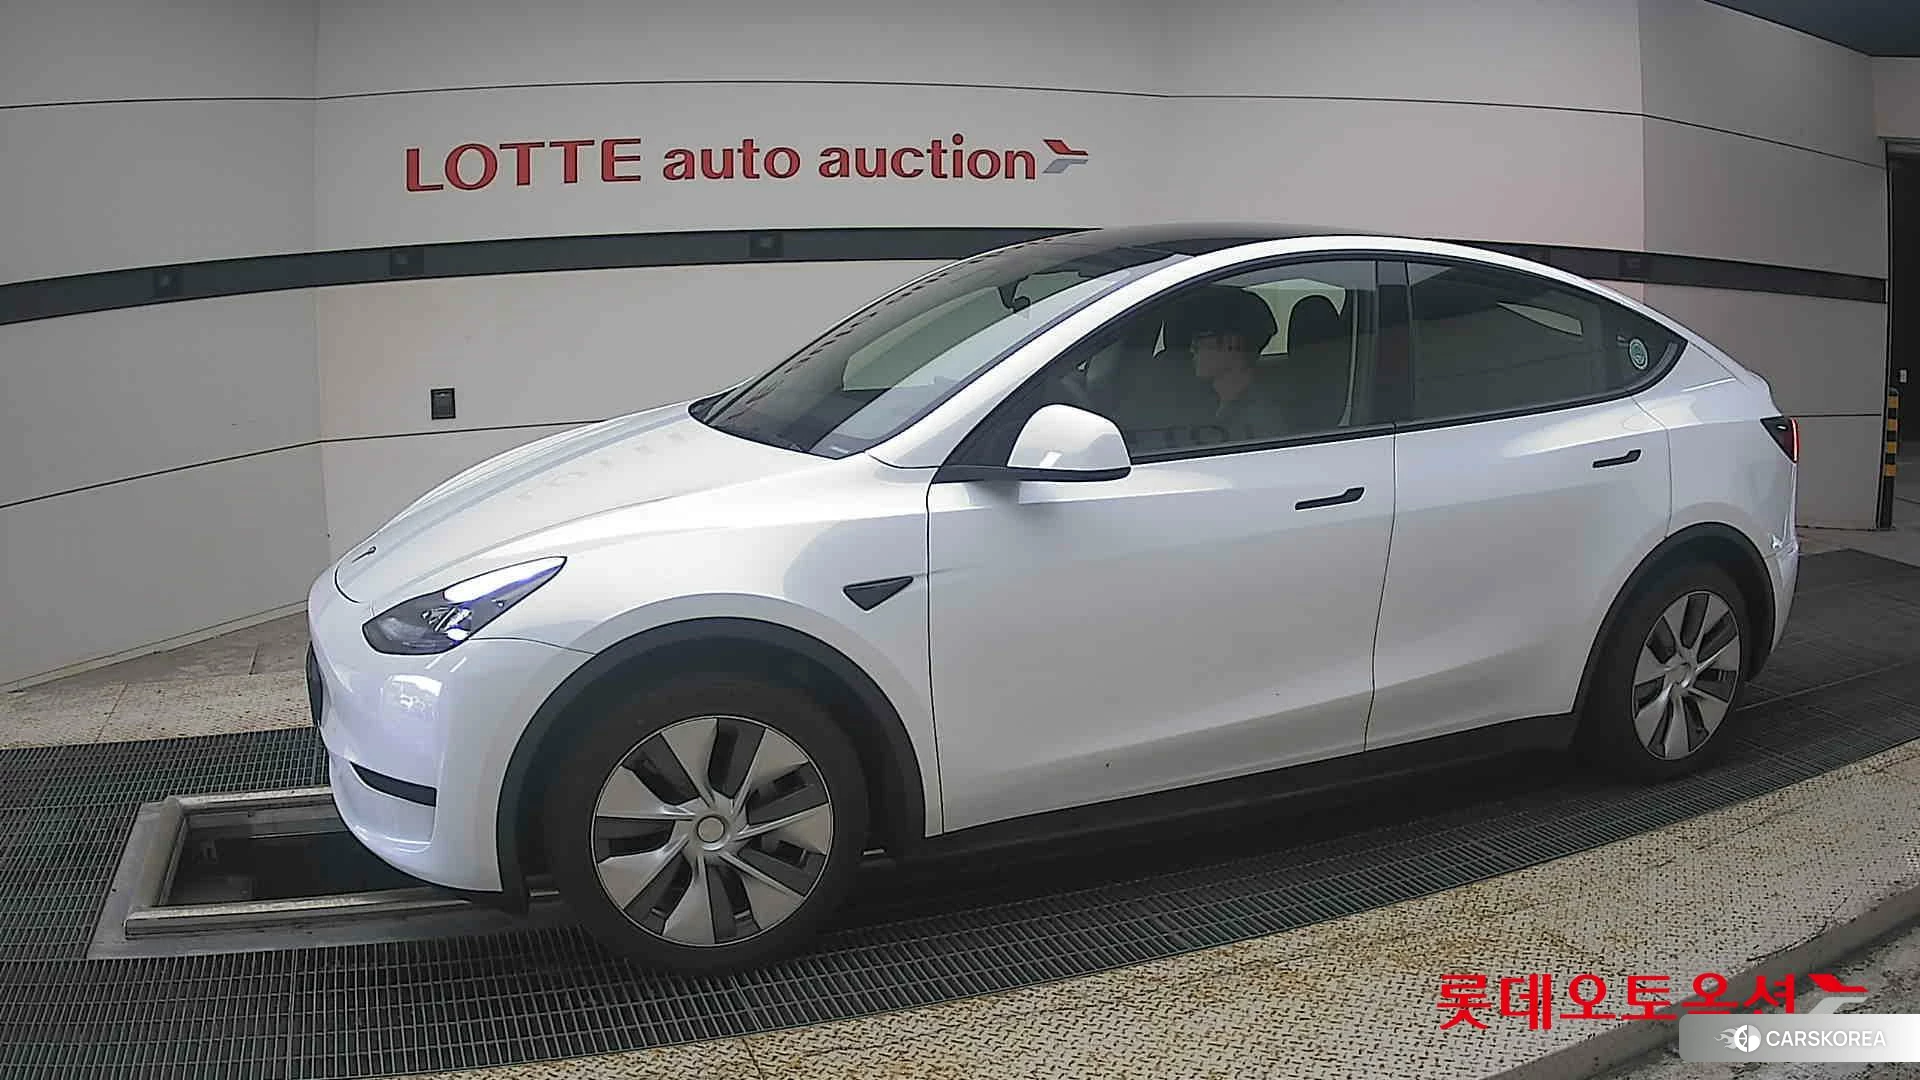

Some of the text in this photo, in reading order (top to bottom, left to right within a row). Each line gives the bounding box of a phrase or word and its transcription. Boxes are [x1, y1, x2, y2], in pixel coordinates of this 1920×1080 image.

[405, 133, 1036, 193] LOTTE auto auction
